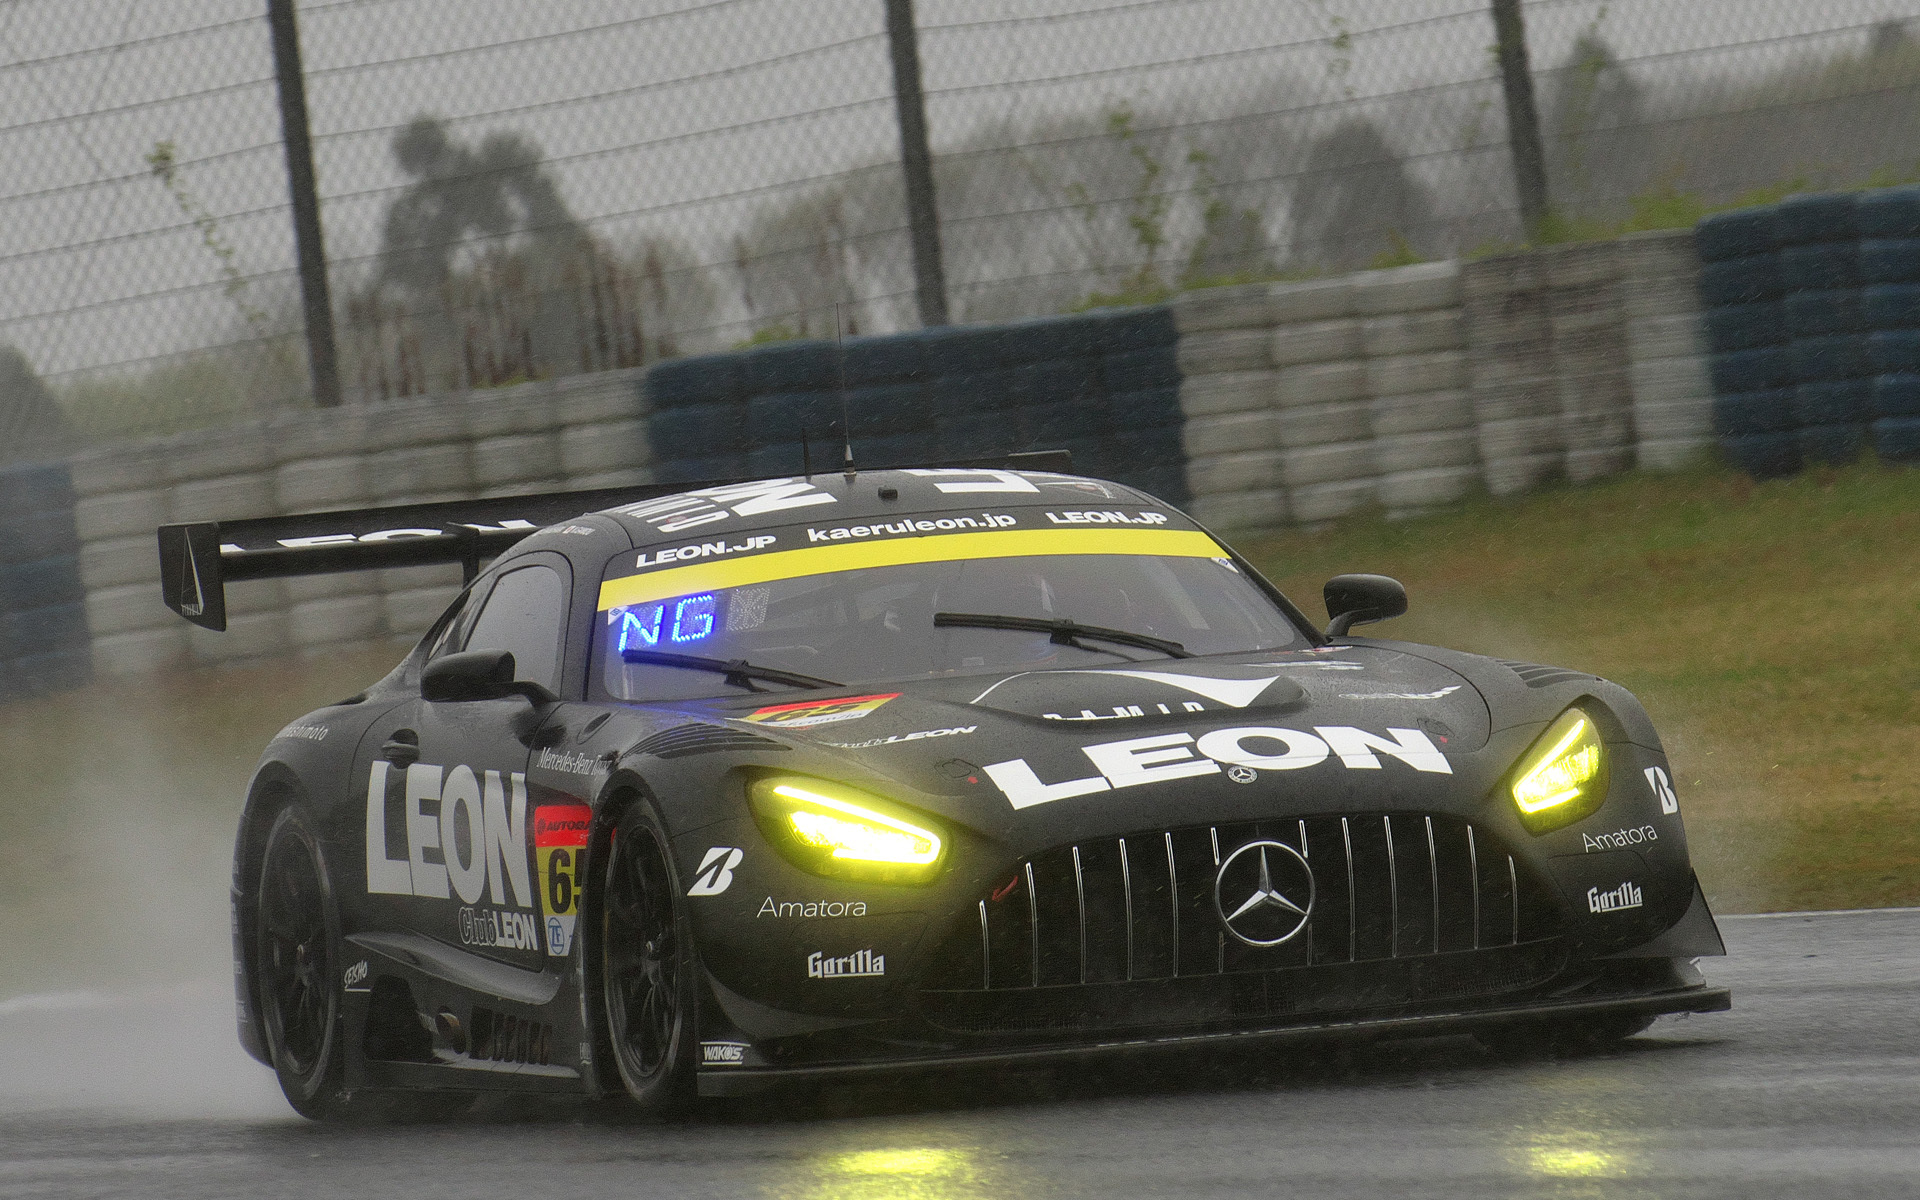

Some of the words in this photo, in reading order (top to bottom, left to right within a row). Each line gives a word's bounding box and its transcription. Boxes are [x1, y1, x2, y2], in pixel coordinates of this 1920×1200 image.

[807, 514, 1016, 542] kaeruleon.jp
[1045, 510, 1168, 525] LEON.JP
[636, 535, 777, 568] LEON.JP
[617, 594, 715, 652] NG
[982, 726, 1454, 810] LEON
[366, 760, 533, 908] LEON
[1582, 825, 1658, 853] Amatora
[757, 896, 867, 918] Amatora
[1587, 881, 1643, 914] Gorilla
[459, 906, 538, 951] ClubLEON
[807, 949, 885, 979] Gorilla
